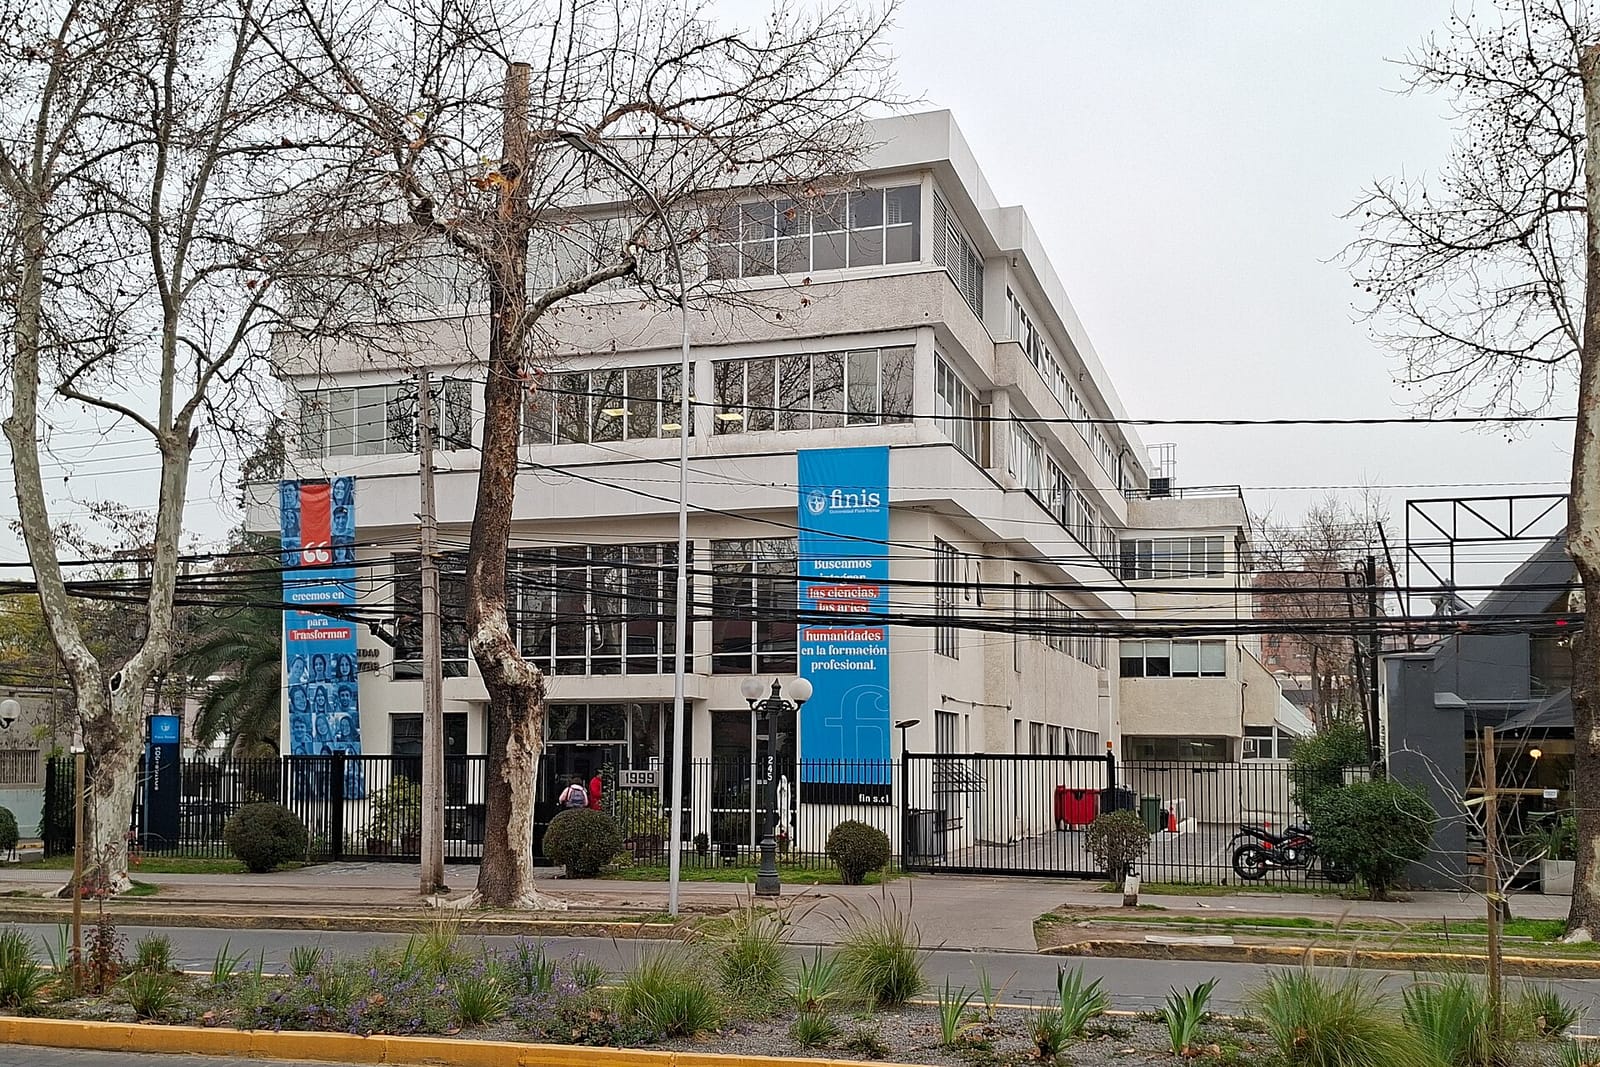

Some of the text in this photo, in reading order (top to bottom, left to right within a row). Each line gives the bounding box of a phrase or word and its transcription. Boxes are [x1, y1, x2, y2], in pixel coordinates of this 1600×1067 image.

[829, 489, 880, 509] finis
[814, 559, 872, 570] Buscamos
[292, 591, 345, 601] creemos en
[307, 618, 329, 629] para
[292, 630, 348, 640] Transformar
[806, 630, 881, 641] humanidades
[801, 644, 887, 656] en la formación
[811, 659, 877, 673] profesional.
[625, 772, 655, 784] 1999
[858, 793, 889, 804] fins.cl
